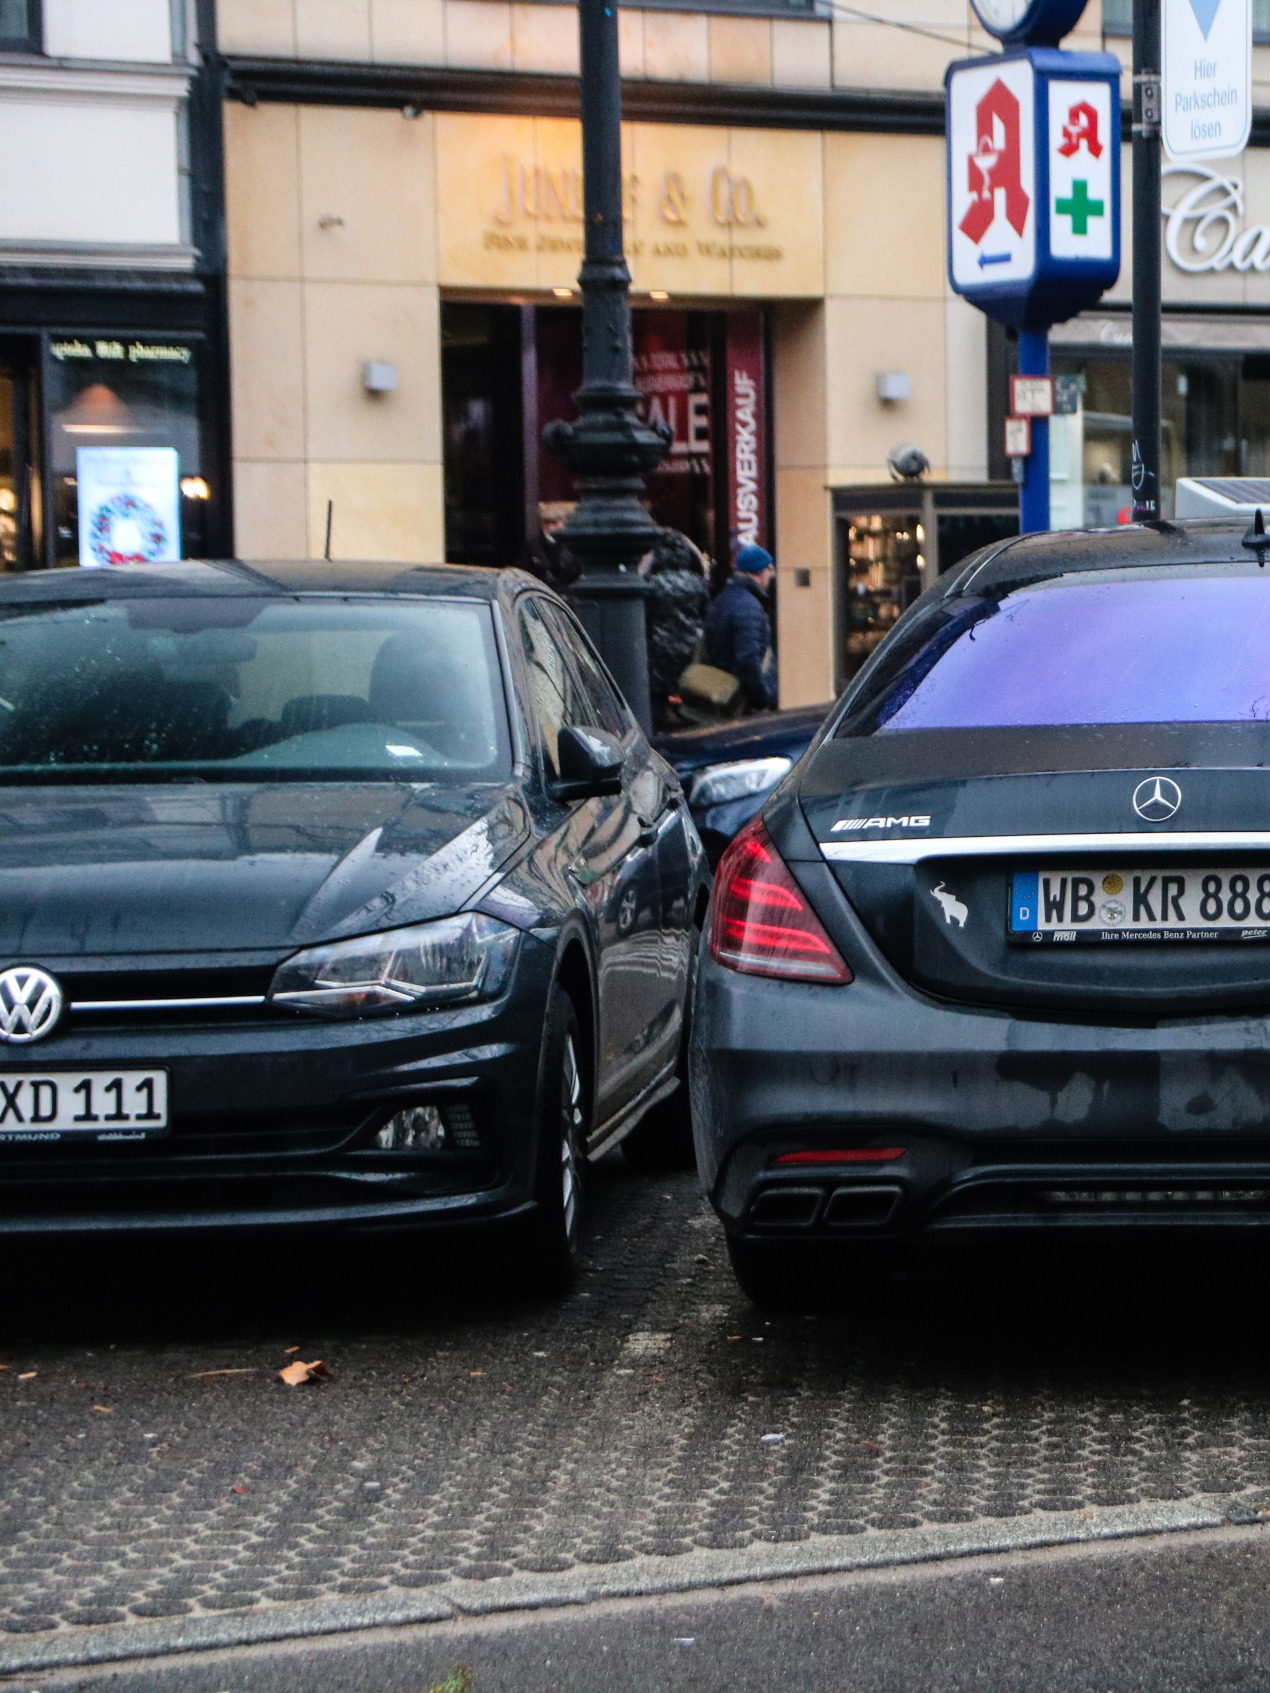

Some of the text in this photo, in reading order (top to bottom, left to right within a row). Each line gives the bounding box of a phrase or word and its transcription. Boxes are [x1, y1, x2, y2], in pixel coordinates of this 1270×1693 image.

[1193, 60, 1218, 79] Hier
[1174, 91, 1238, 114] Parkschein
[1190, 119, 1222, 141] lösen
[659, 170, 689, 227] &
[128, 341, 191, 363] pharmacy
[734, 369, 759, 547] AUSVERKAUF
[862, 815, 932, 830] AMG
[1042, 877, 1096, 923] WB
[1132, 875, 1186, 922] KR
[1019, 906, 1030, 920] D
[1101, 931, 1120, 940] Ihre
[1121, 930, 1161, 939] Mercedes
[1163, 930, 1185, 939] Benz
[1186, 930, 1219, 939] Partner
[0, 1076, 162, 1123] XD 111
